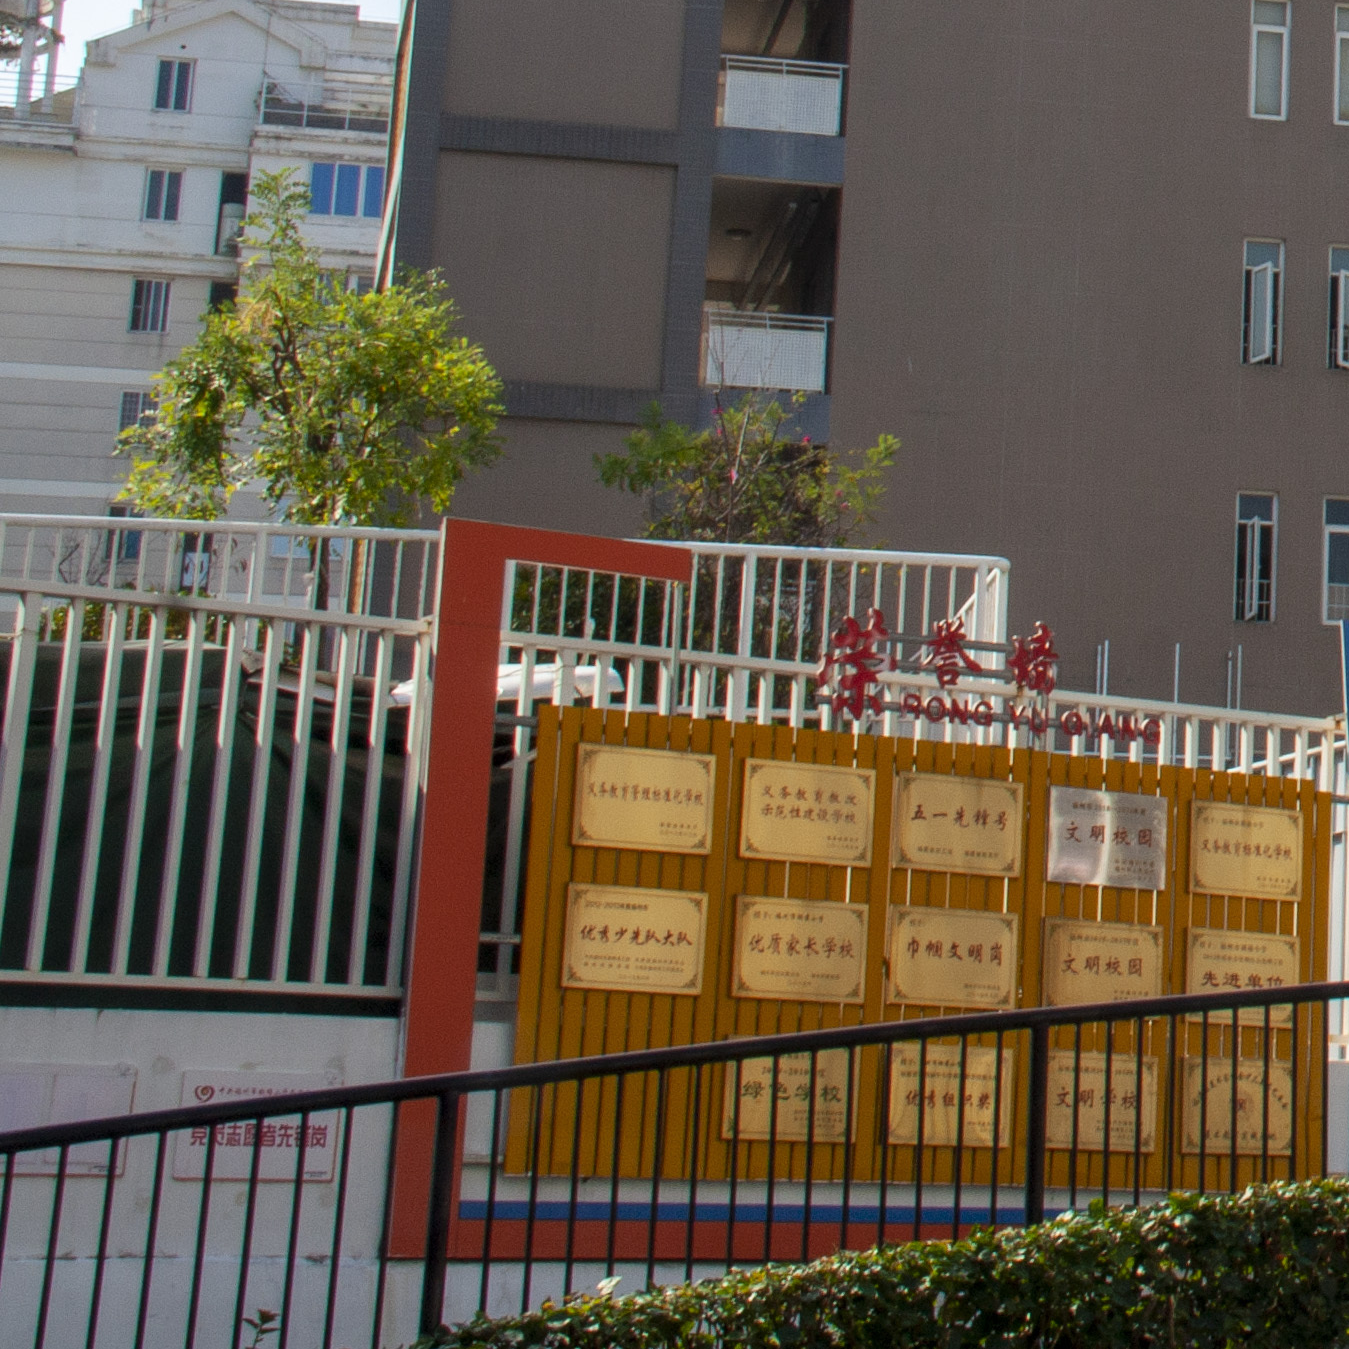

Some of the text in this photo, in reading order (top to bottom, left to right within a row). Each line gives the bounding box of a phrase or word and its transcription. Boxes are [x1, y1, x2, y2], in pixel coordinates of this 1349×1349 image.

[818, 607, 1059, 722] 荣誉墙
[902, 693, 1163, 746] RONG YU QIANG
[911, 803, 1007, 832] 五一先锋号
[1064, 820, 1154, 848] 文明校园
[580, 924, 693, 947] 优秀少先队大队
[748, 933, 855, 959] 优质家长学校
[907, 937, 1003, 967] 巾帼文明岗
[1061, 953, 1143, 978] 文明校园
[1201, 970, 1285, 989] 先进单位
[741, 1081, 842, 1103] 绿色学校
